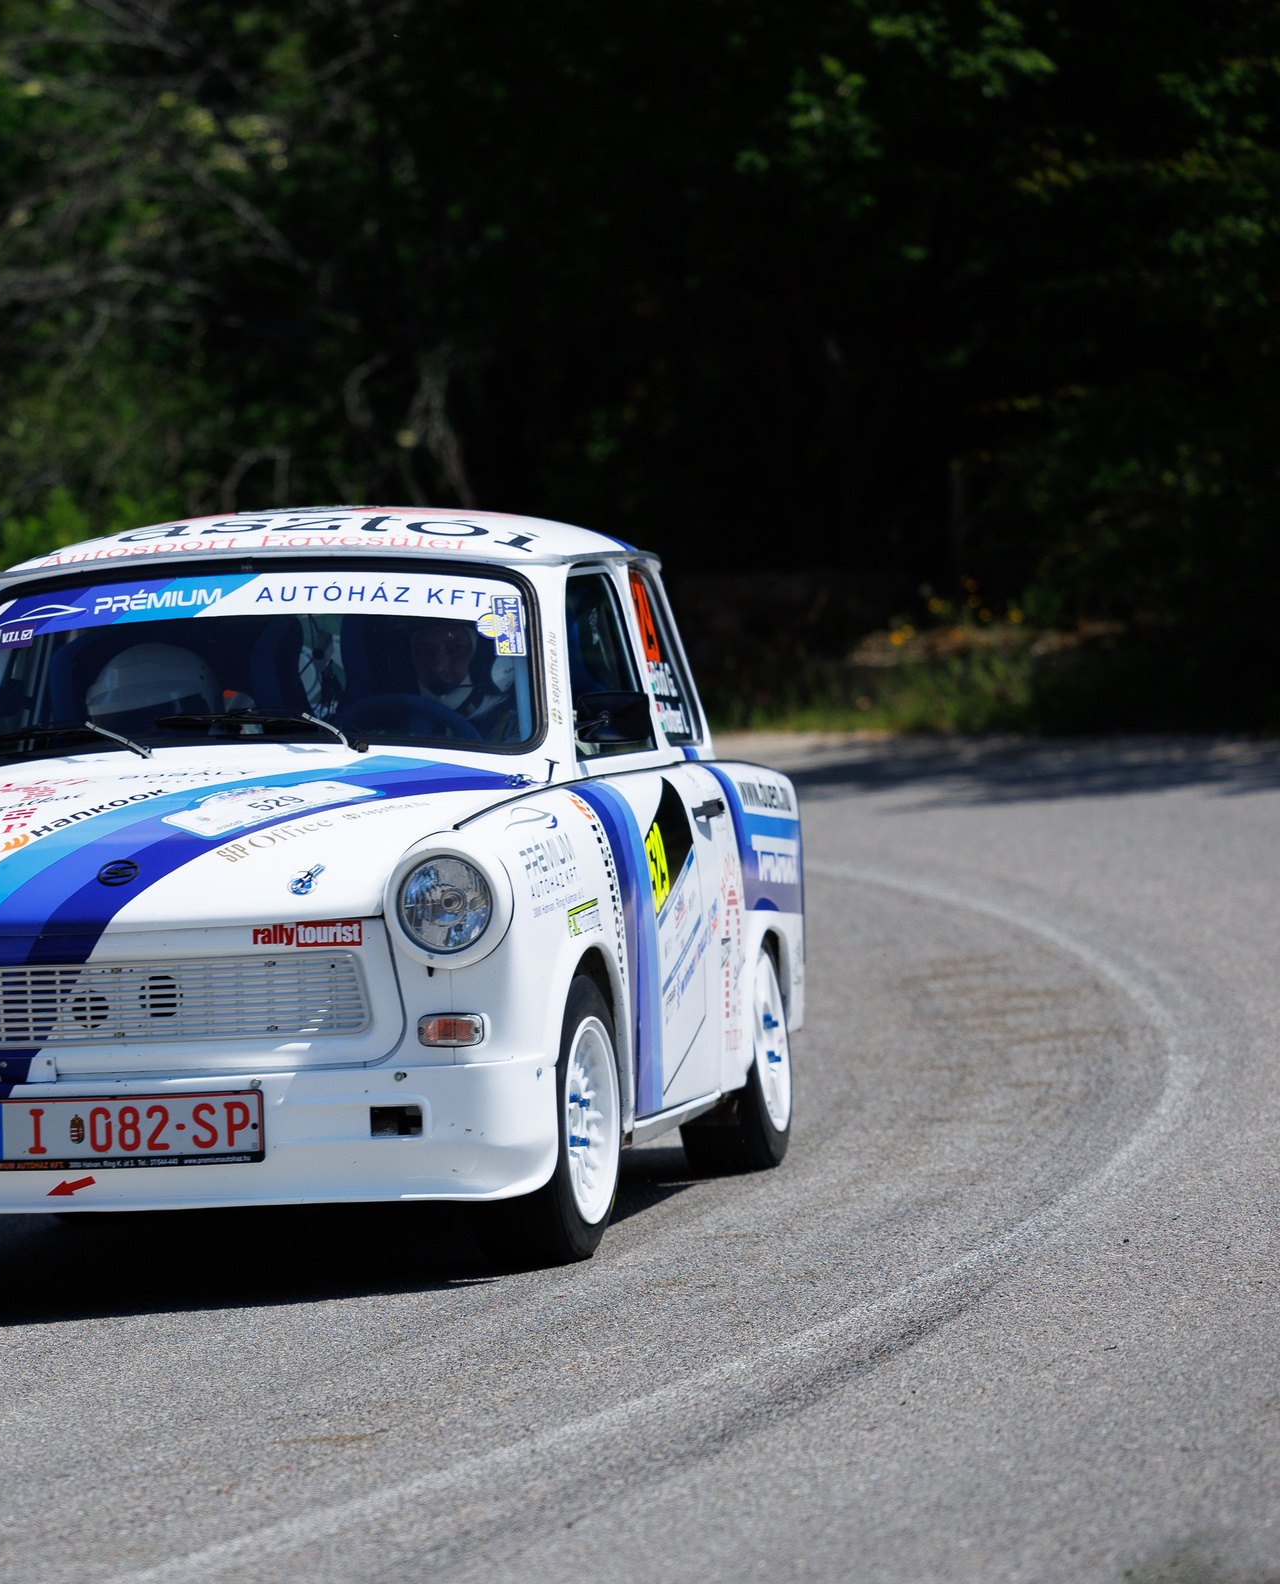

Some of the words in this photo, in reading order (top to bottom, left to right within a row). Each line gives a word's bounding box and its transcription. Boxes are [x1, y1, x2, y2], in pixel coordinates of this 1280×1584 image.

[39, 537, 240, 567] Autosport
[94, 588, 222, 614] PRÉMIUM
[255, 581, 410, 603] AUTÓHÁZ
[30, 788, 170, 838] Hankook
[247, 795, 305, 812] 529
[216, 843, 250, 863] SEP
[248, 817, 334, 849] Office
[645, 822, 670, 914] 529
[89, 1101, 251, 1152] 082-SP
